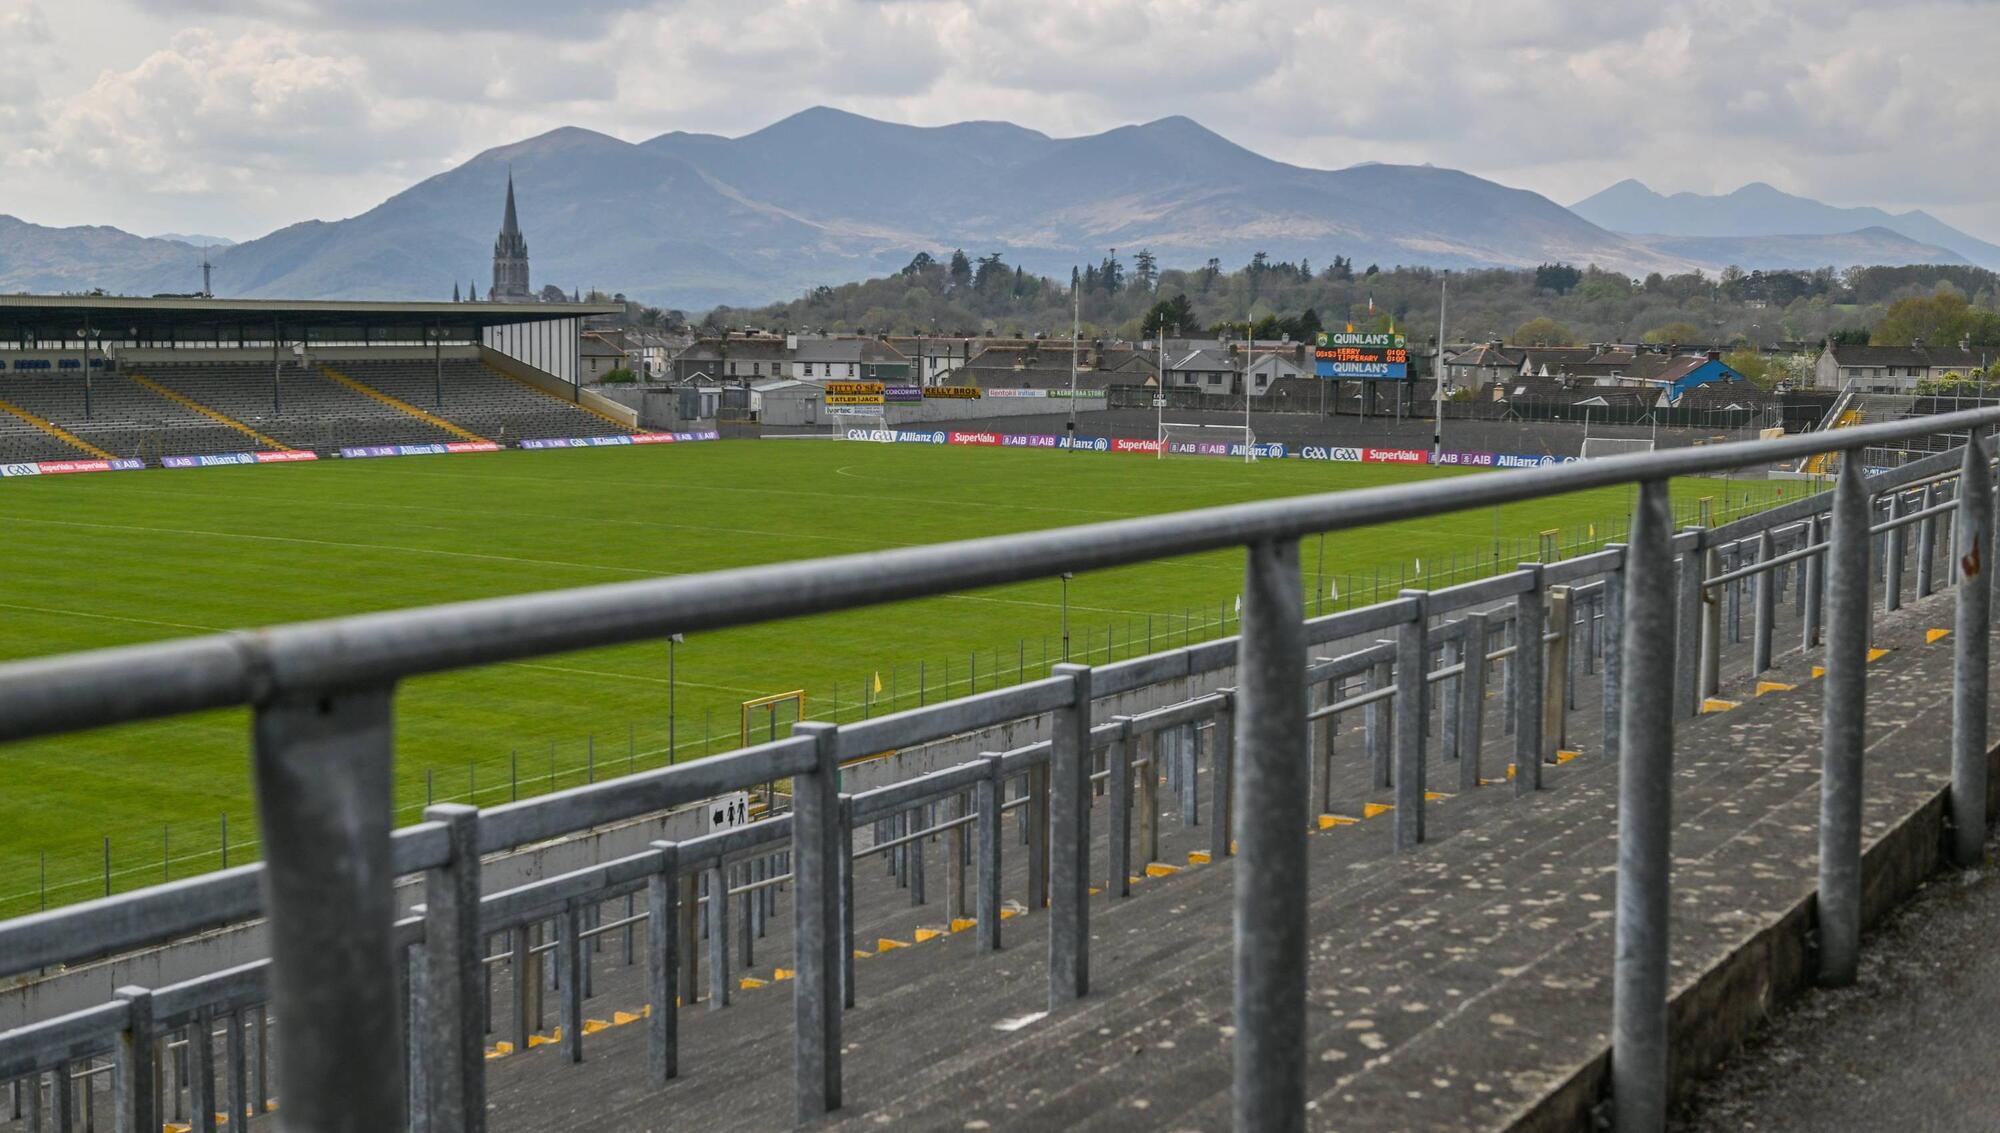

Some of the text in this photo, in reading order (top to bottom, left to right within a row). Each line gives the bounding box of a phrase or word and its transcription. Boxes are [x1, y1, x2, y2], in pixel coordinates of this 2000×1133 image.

[1333, 334, 1389, 344] QUINLAN'S
[1338, 354, 1378, 362] TIPPERARY
[1332, 362, 1388, 373] QUINLAN'S
[924, 387, 951, 395] KELLY
[899, 432, 931, 442] Allianz
[954, 433, 995, 443] SuperValu
[1011, 436, 1027, 445] AIB
[1038, 438, 1054, 446] AIB
[353, 449, 367, 457] AIB
[400, 445, 432, 456] Allianz
[1179, 443, 1196, 453] AIB
[1209, 444, 1226, 454] AIB
[1231, 444, 1267, 456] Allanz
[201, 455, 239, 466] Allianz
[1369, 450, 1419, 461] SuperValu
[1440, 453, 1458, 463] AIB
[1473, 455, 1491, 465] AIB
[123, 459, 140, 468] AIB
[176, 458, 192, 466] AIB
[1497, 455, 1538, 467] Allianz
